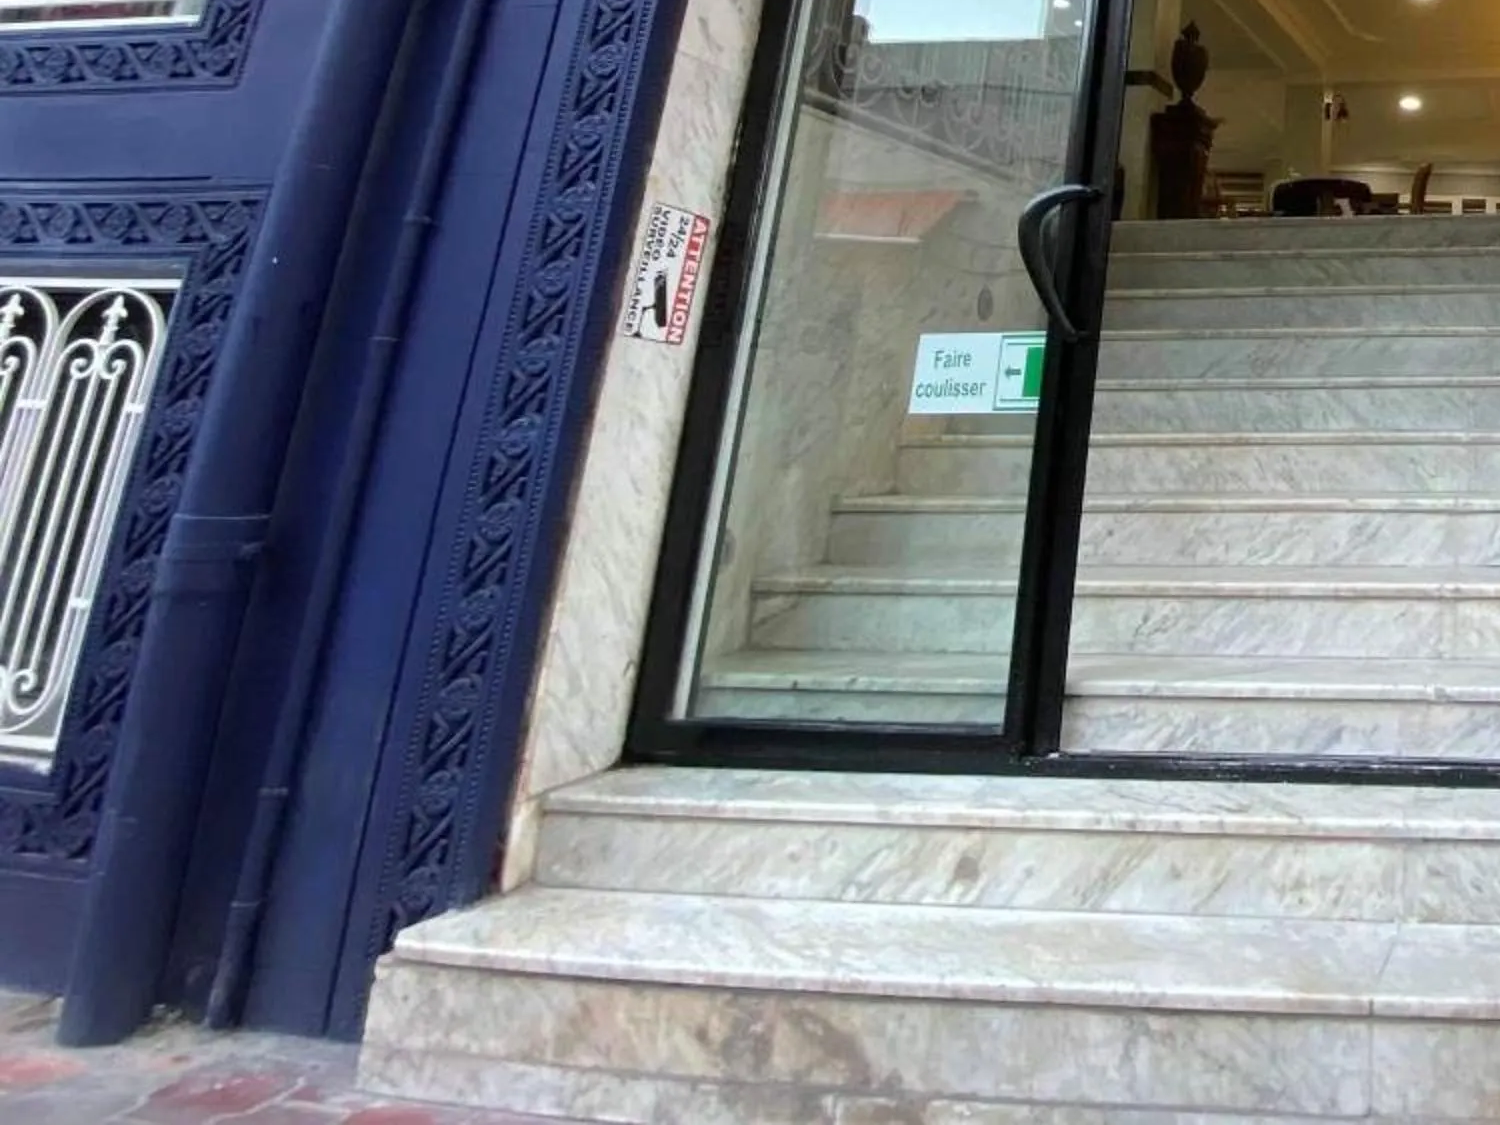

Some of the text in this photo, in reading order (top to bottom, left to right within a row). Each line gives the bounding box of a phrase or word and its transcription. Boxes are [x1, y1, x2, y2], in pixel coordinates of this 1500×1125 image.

[651, 210, 671, 262] VIDEO
[666, 216, 690, 259] 24/24
[624, 206, 662, 332] SURVEILLANCE
[667, 218, 707, 342] ATTENTION
[933, 350, 972, 369] Faire
[915, 378, 987, 398] coulisser
